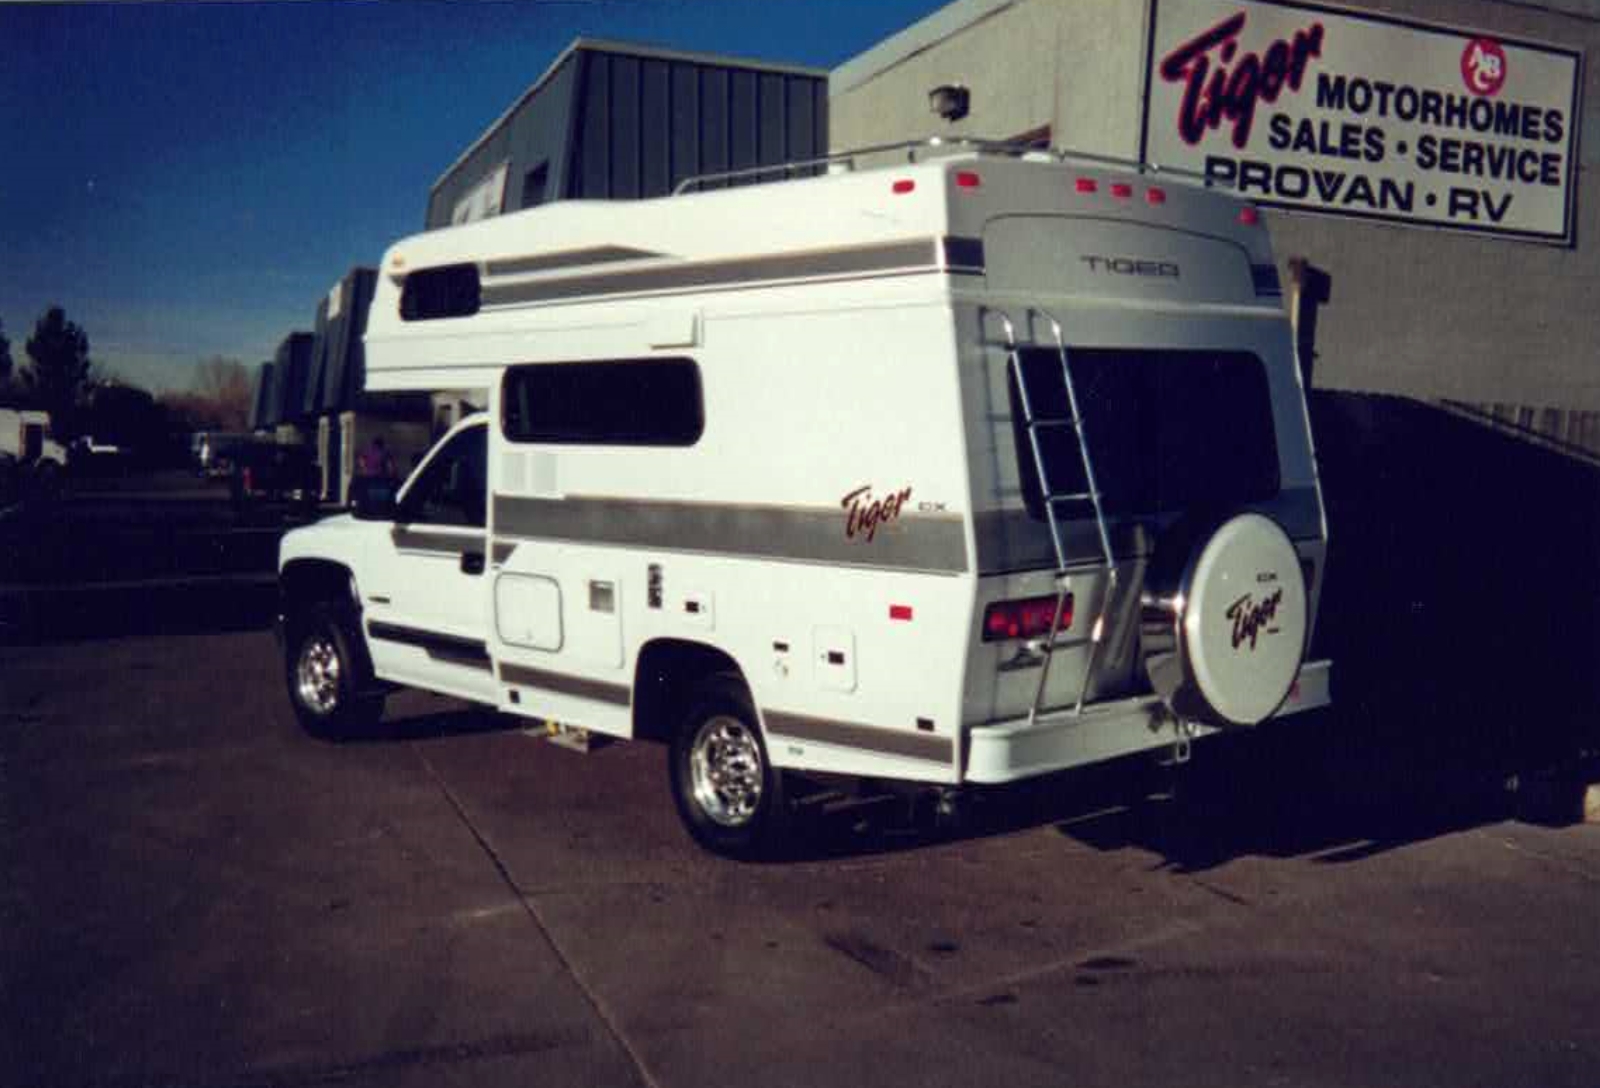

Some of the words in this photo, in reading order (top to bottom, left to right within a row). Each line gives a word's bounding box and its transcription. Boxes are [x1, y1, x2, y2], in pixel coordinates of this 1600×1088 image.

[1160, 10, 1325, 150] Tiger
[1316, 73, 1564, 143] MOTORHOMES
[1269, 113, 1386, 163] SALES
[1416, 135, 1562, 186] SERVICE
[1204, 155, 1414, 212] PROVAN
[1448, 186, 1514, 224] RV
[841, 484, 912, 543] Tiger
[1226, 587, 1283, 651] Tiger
